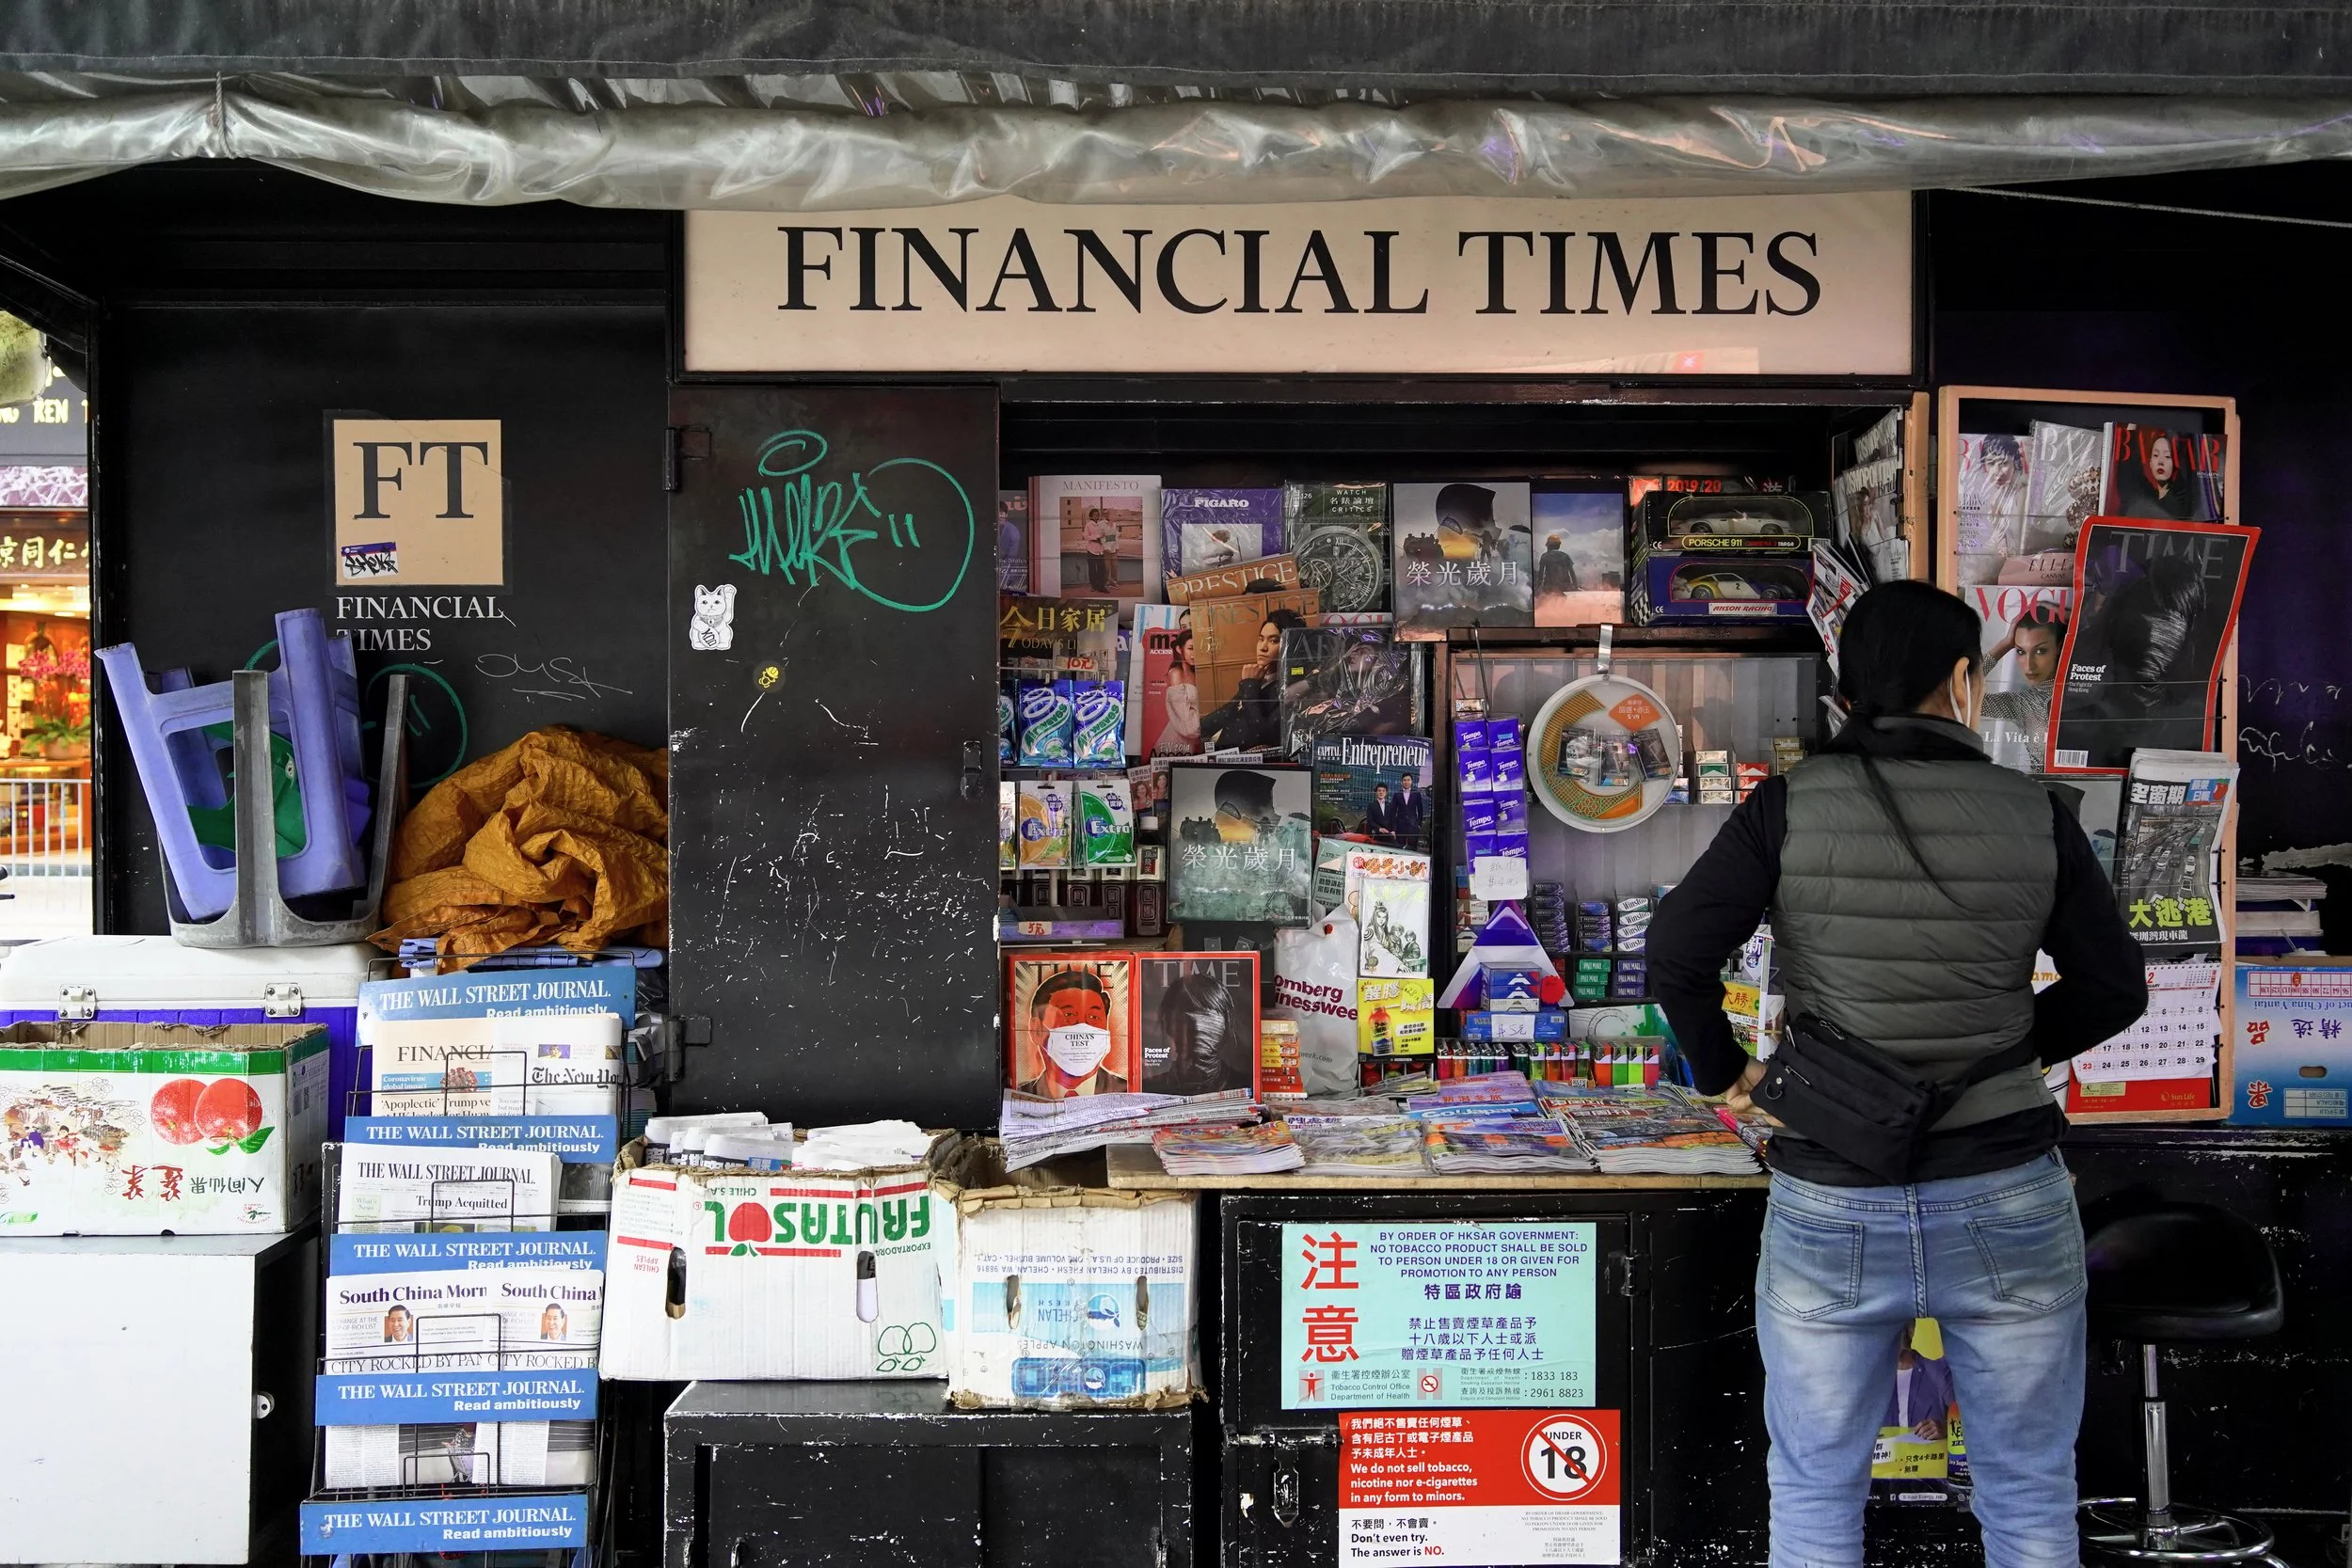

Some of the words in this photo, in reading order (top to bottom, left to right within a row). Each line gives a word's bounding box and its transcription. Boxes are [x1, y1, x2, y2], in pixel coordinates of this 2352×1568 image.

[777, 226, 1429, 314] FINANCIAL
[1458, 230, 1820, 318] TIMES
[34, 398, 69, 423] REN
[352, 441, 488, 520] FT
[1062, 481, 1139, 491] MANIFESTO
[1194, 499, 1249, 508] FIGARO
[1689, 538, 1728, 547] PORSCHE
[1730, 538, 1742, 546] 911
[0, 536, 89, 569] 京同仁
[2028, 558, 2068, 572] ELLE
[1406, 561, 1518, 587] 榮光歲月
[336, 595, 504, 620] FINANCIAL
[999, 605, 1105, 633] 今日家居
[2071, 663, 2100, 673] Faces
[2102, 664, 2106, 673] of
[2070, 673, 2102, 682] Protest
[1342, 736, 1429, 774] Entrepreneur
[1466, 759, 1486, 769] Tempo
[2130, 782, 2186, 805] 空窗期
[1091, 820, 1130, 834] Extra
[1467, 815, 1492, 827] Tempo
[1027, 822, 1067, 836] Extra
[1182, 845, 1295, 872] 榮光歲月
[1625, 911, 1650, 925] Winston
[2128, 897, 2213, 928] 大逃港
[1746, 935, 1763, 956] 新
[2147, 973, 2154, 983] 2
[380, 991, 413, 1011] THE
[418, 988, 462, 1007] WALL
[466, 983, 531, 1005] STREET
[532, 979, 612, 1001] JOURNAL.
[2254, 1001, 2288, 1010] Yantai
[2292, 1001, 2322, 1010] China
[532, 1067, 561, 1085] The
[367, 1126, 402, 1140] THE
[406, 1126, 453, 1140] WALL
[456, 1125, 522, 1140] STREET
[524, 1125, 604, 1139] JOURNAL.
[358, 1162, 385, 1179] THE
[388, 1164, 423, 1180] WALL
[426, 1164, 476, 1181] STREET
[416, 1195, 453, 1211] Trump
[454, 1197, 507, 1210] Acquitted
[1379, 1231, 1394, 1241] BY
[1397, 1231, 1437, 1241] ORDER
[1439, 1231, 1454, 1241] OF
[1458, 1231, 1496, 1241] HKSAR
[1500, 1231, 1579, 1241] GOVERNMENT:
[354, 1243, 390, 1258] THE
[393, 1243, 441, 1258] WALL
[446, 1243, 513, 1257] STREET
[516, 1242, 596, 1256] JOURNAL.
[875, 1242, 930, 1257] EXPORTADORA
[1370, 1243, 1387, 1253] NO
[1389, 1243, 1441, 1253] TOBACCO
[1445, 1243, 1498, 1253] PRODUCT
[1501, 1243, 1537, 1253] SHALL
[1540, 1243, 1554, 1253] BE
[1558, 1243, 1588, 1253] SOLD
[1378, 1256, 1392, 1265] TO
[1396, 1256, 1441, 1265] PERSON
[1445, 1256, 1483, 1265] UNDER
[1486, 1256, 1498, 1265] 18
[1501, 1256, 1518, 1265] OR
[1520, 1256, 1554, 1265] GIVEN
[1557, 1256, 1580, 1265] FOR
[340, 1287, 389, 1306] South
[392, 1286, 443, 1302] China
[501, 1282, 548, 1299] South
[550, 1284, 597, 1301] China
[1300, 1231, 1359, 1363] 注意
[1424, 1283, 1522, 1300] 特區政府諭
[1408, 1317, 1537, 1330] 禁止售賣煙草產品予
[1057, 1338, 1143, 1350] WASHINGTON
[331, 1360, 368, 1374] CITY
[371, 1356, 432, 1372] ROCKED
[436, 1354, 453, 1369] BY
[338, 1385, 375, 1401] THE
[379, 1384, 427, 1399] WALL
[431, 1382, 500, 1398] STREET
[502, 1380, 585, 1396] JOURNAL.
[1331, 1383, 1360, 1391] Tobacco
[1362, 1383, 1387, 1391] Control
[1388, 1383, 1411, 1391] Office
[453, 1400, 491, 1411] Read
[494, 1398, 581, 1411] ambitiously
[1351, 1432, 1474, 1445] 含有尼古丁或電子煙產品
[1546, 1431, 1582, 1441] UNDER
[1351, 1464, 1368, 1474] We
[1371, 1463, 1384, 1473] do
[1387, 1464, 1405, 1473] not
[1407, 1463, 1424, 1473] sell
[1427, 1462, 1472, 1474] tobacco,
[1540, 1446, 1587, 1480] 18
[1351, 1478, 1393, 1488] nicotine
[1416, 1477, 1478, 1489] e-cigarettes
[1351, 1492, 1360, 1502] in
[1363, 1494, 1382, 1505] any
[1385, 1492, 1409, 1502] form
[1412, 1492, 1423, 1501] to
[1426, 1491, 1465, 1501] minors.
[325, 1513, 362, 1529] THE
[366, 1512, 415, 1528] WALL
[420, 1510, 490, 1526] STREET
[492, 1508, 576, 1523] JOURNAL.
[443, 1528, 480, 1541] Read
[484, 1526, 572, 1539] ambitiously
[1351, 1547, 1371, 1558] The
[1373, 1549, 1411, 1558] answer
[1413, 1547, 1422, 1557] is
[1424, 1545, 1445, 1557] NO.
